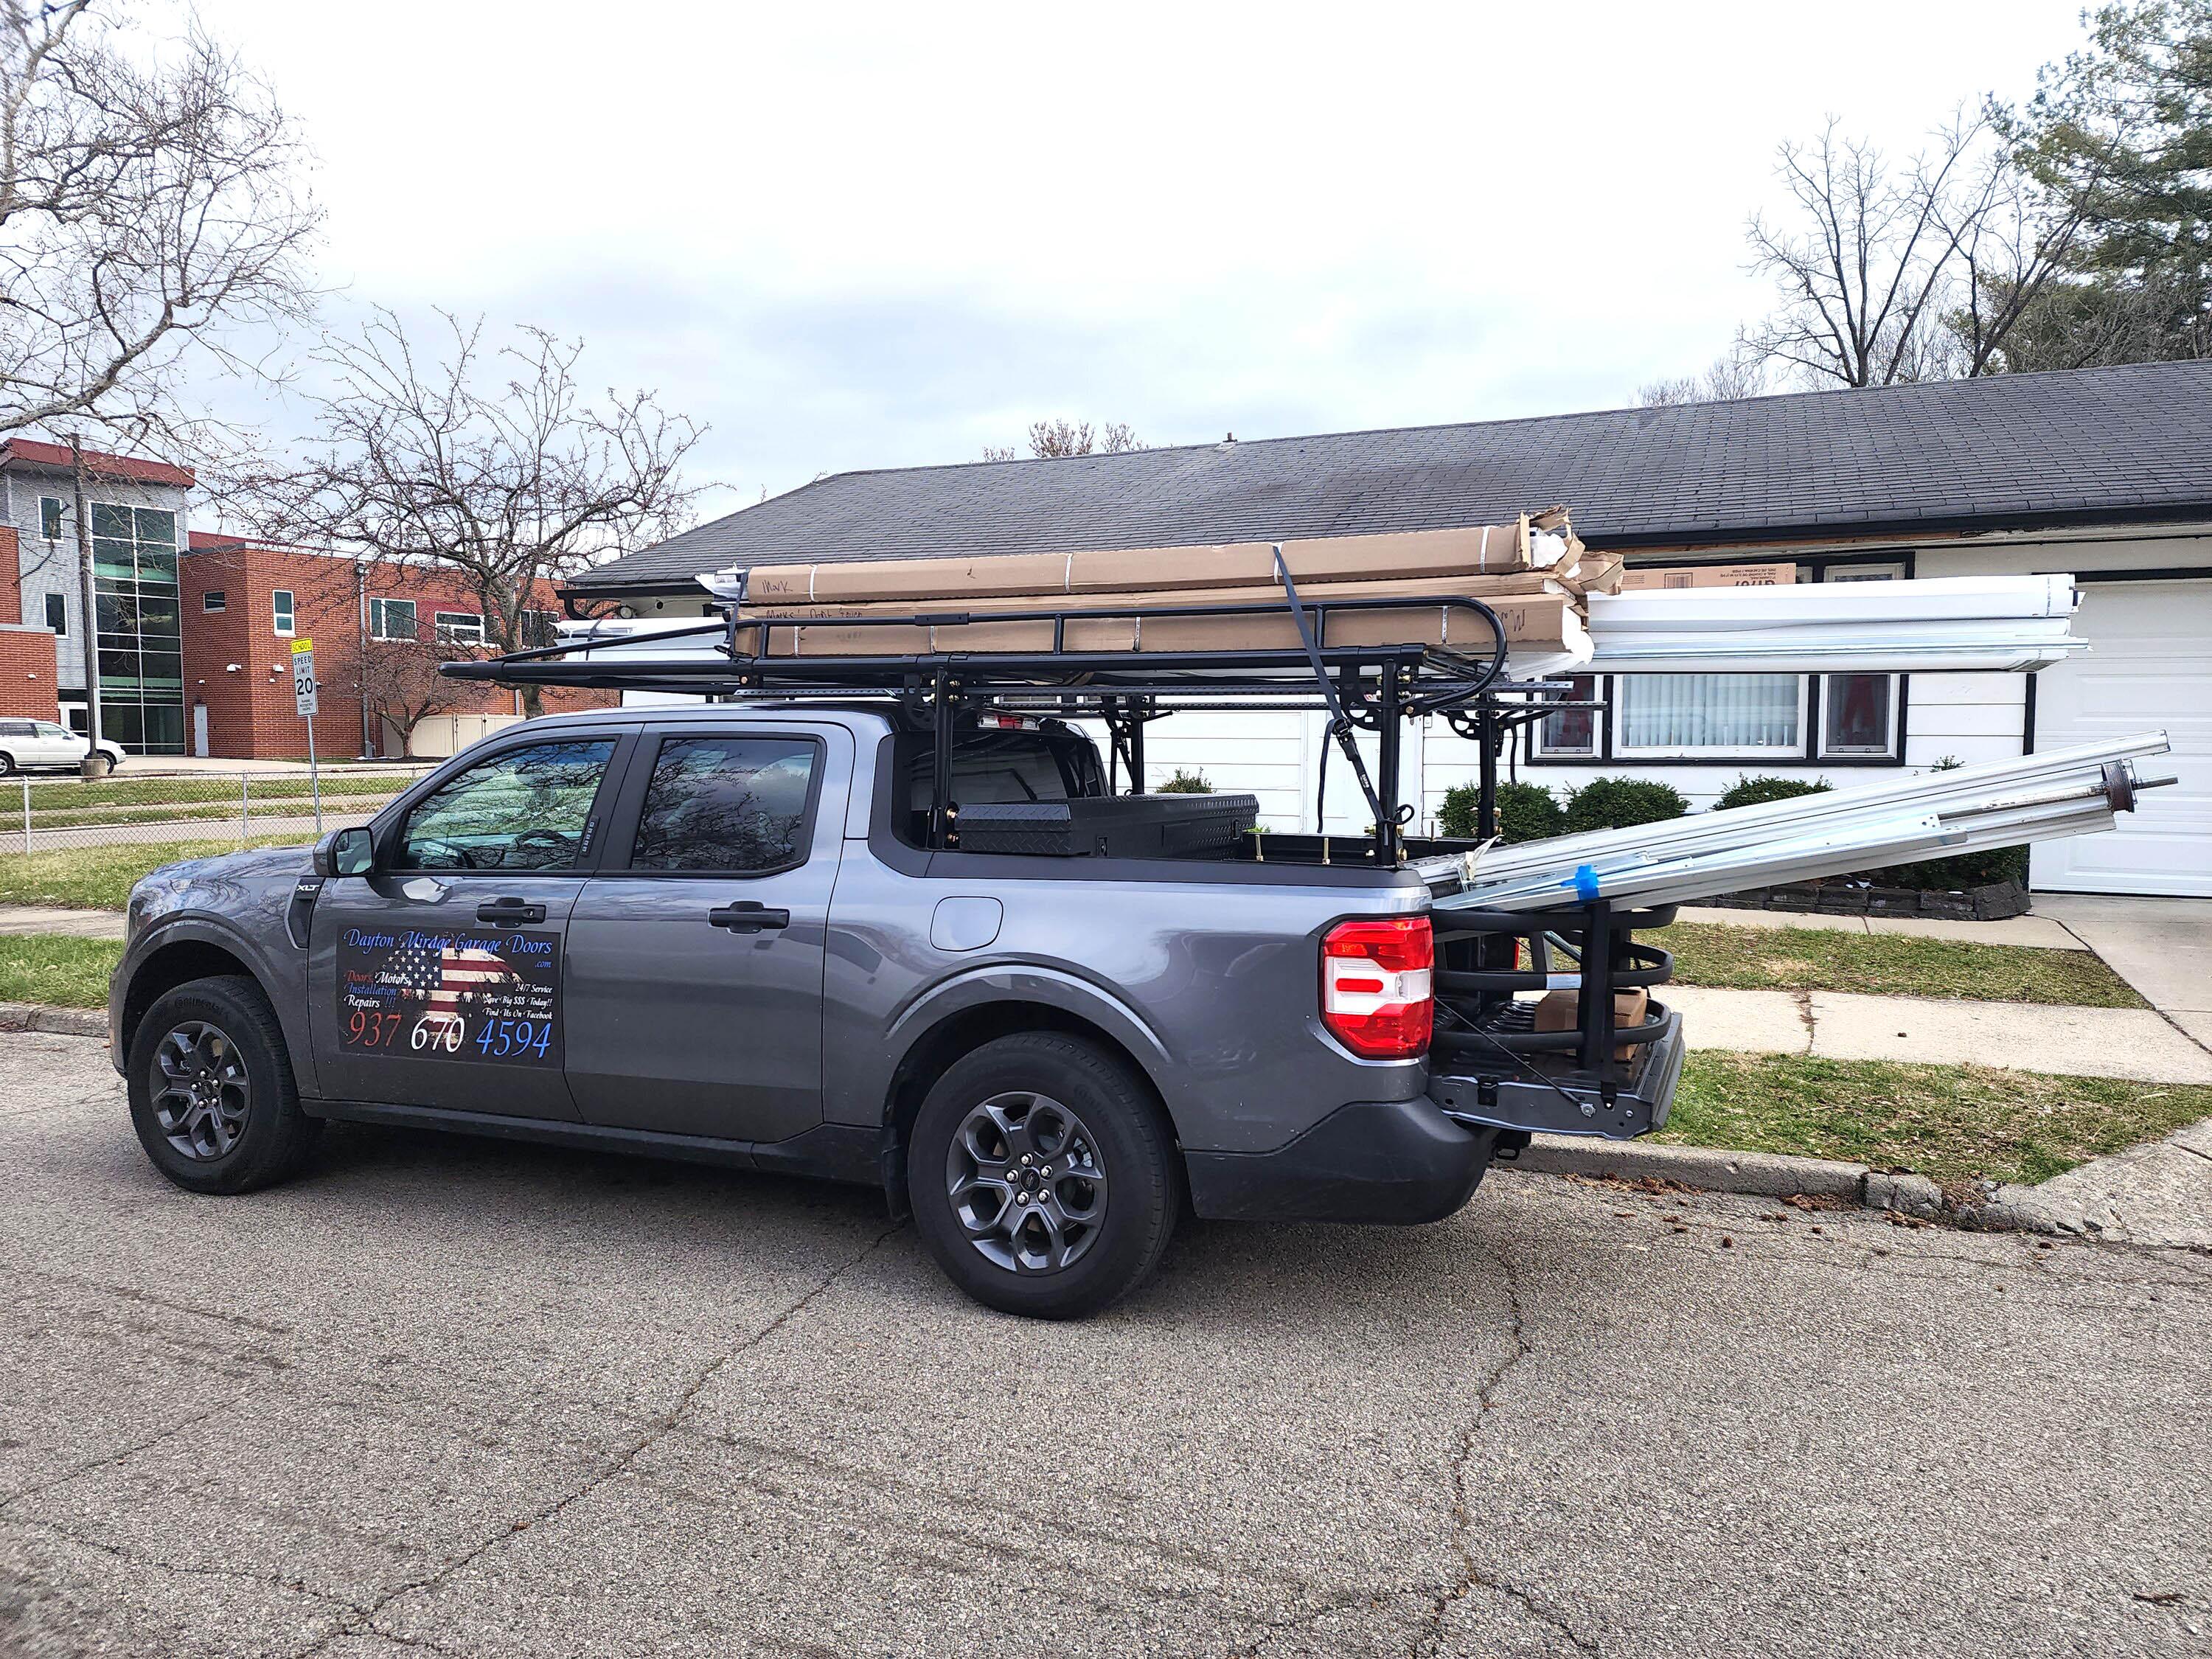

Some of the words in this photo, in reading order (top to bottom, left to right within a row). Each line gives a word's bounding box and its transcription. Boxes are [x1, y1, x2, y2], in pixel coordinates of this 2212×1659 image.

[762, 580, 793, 594] Mark
[293, 642, 310, 651] SCHOOL
[294, 655, 311, 665] SPEED
[296, 667, 310, 675] LIMIT
[296, 678, 313, 695] 20
[344, 928, 394, 955] Dayton
[398, 931, 451, 957] Mirage
[455, 933, 501, 956] Garage
[506, 934, 553, 954] Doors
[535, 960, 552, 968] .com
[344, 982, 397, 997] Installation
[515, 983, 531, 992] 24/7
[531, 984, 553, 993] Service
[344, 994, 380, 1012] Repairs
[499, 995, 512, 1007] Big
[513, 996, 526, 1006] $$$
[526, 997, 553, 1009] Today!!
[481, 1007, 499, 1017] Find
[500, 1008, 512, 1017] Us
[512, 1009, 522, 1018] On
[523, 1009, 553, 1020] Facebook
[347, 1011, 402, 1047] 937
[411, 1015, 465, 1053] 670
[476, 1018, 552, 1059] 4594
